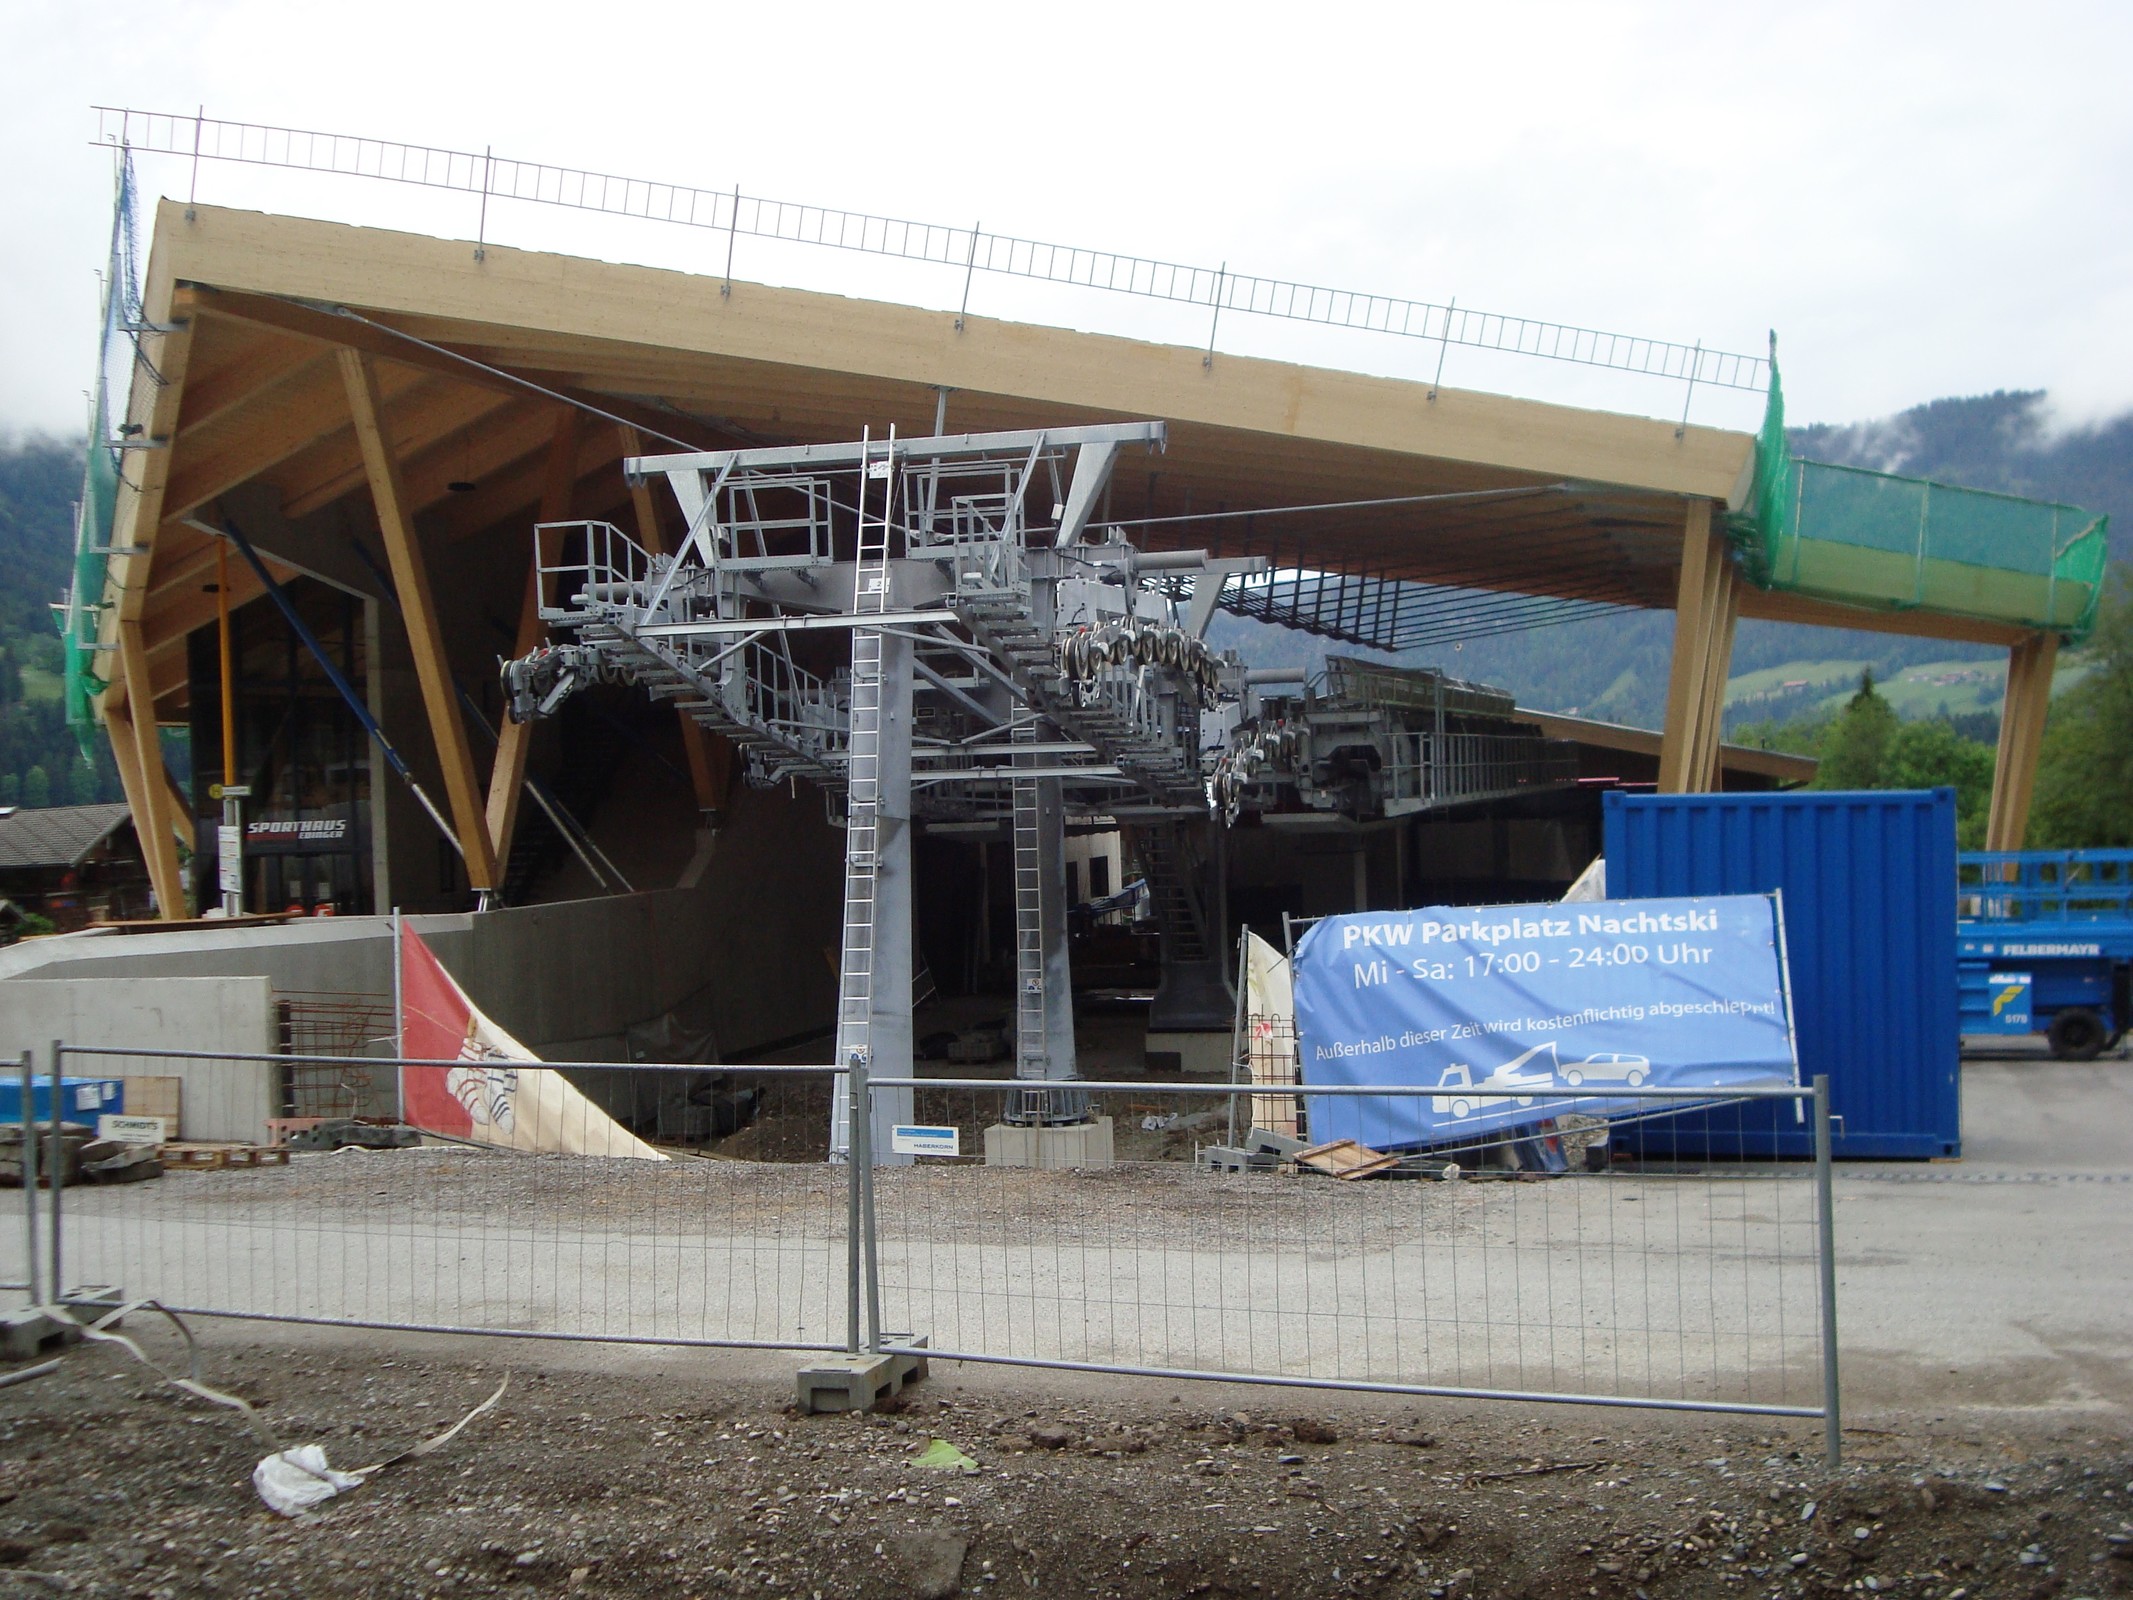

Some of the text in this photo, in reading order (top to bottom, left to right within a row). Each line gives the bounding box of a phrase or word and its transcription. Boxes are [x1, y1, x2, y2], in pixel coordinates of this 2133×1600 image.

[248, 820, 347, 833] SPORTHAUS
[298, 831, 344, 839] EDINGER
[1343, 909, 1718, 949] PKW Parkplatz Nachtski
[2003, 943, 2100, 956] FELBERMAYR
[1354, 960, 1388, 989] Mi
[1413, 958, 1453, 980] Sa:
[1464, 951, 1540, 977] 17:00
[1568, 943, 1648, 968] 24:00
[1658, 943, 1713, 964] Uhr
[1316, 1035, 1396, 1061] Außerhalb
[1400, 1029, 1447, 1048] dieser
[1451, 1021, 1482, 1040] Zeit
[1483, 1018, 1521, 1034] wird
[1527, 1005, 1645, 1031] kostenflichtig
